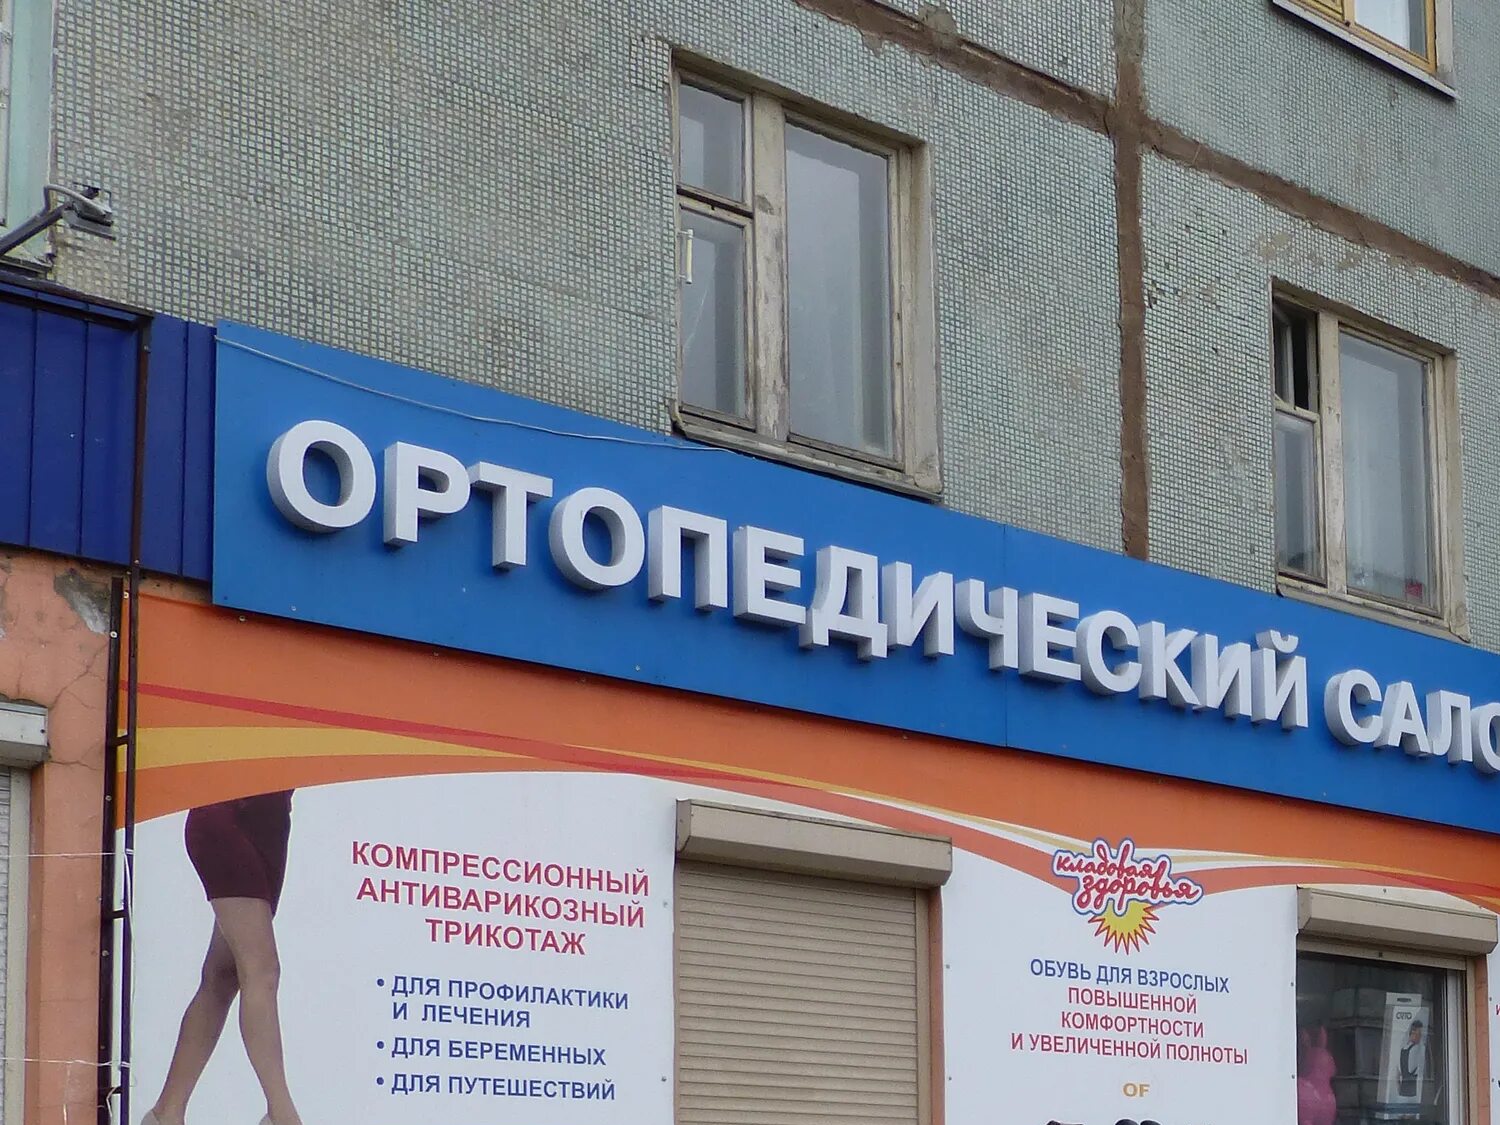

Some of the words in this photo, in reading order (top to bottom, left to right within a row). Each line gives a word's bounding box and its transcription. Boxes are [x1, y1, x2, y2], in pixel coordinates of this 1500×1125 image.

[266, 420, 1308, 730] ОРТОПЕДИЧЕСКИЙ
[351, 841, 650, 897] КОМПРЕССИОННЫЙ
[1056, 842, 1167, 879] кладовая
[356, 877, 645, 929] АНТИВАРИКОЗНЫЙ
[1077, 875, 1200, 911] здоровья
[425, 918, 587, 956] ТРИКОТАЖ
[391, 975, 440, 998] ДЛЯ
[448, 980, 629, 1010] ПРОФИЛАКТИКИ
[1030, 958, 1092, 981] ОБУВЬ
[1096, 964, 1132, 986] ДЛЯ
[1138, 969, 1230, 994] ВЗРОСЛЫХ
[393, 1002, 408, 1021] И
[422, 1003, 531, 1028] ЛЕЧЕНИЯ
[1068, 986, 1197, 1014] ПОВЫШЕННОЙ
[1061, 1011, 1204, 1038] КОМФОРТНОСТИ
[391, 1036, 440, 1058] ДЛЯ
[448, 1040, 606, 1066] БЕРЕМЕННЫХ
[1011, 1033, 1023, 1050] И
[1029, 1033, 1161, 1059] УВЕЛИЧЕННОЙ
[1167, 1042, 1248, 1064] ПОЛНОТЫ
[391, 1073, 440, 1095] ДЛЯ
[448, 1076, 616, 1101] ПУТЕШЕСТВИЙ
[1122, 1083, 1151, 1097] OF
